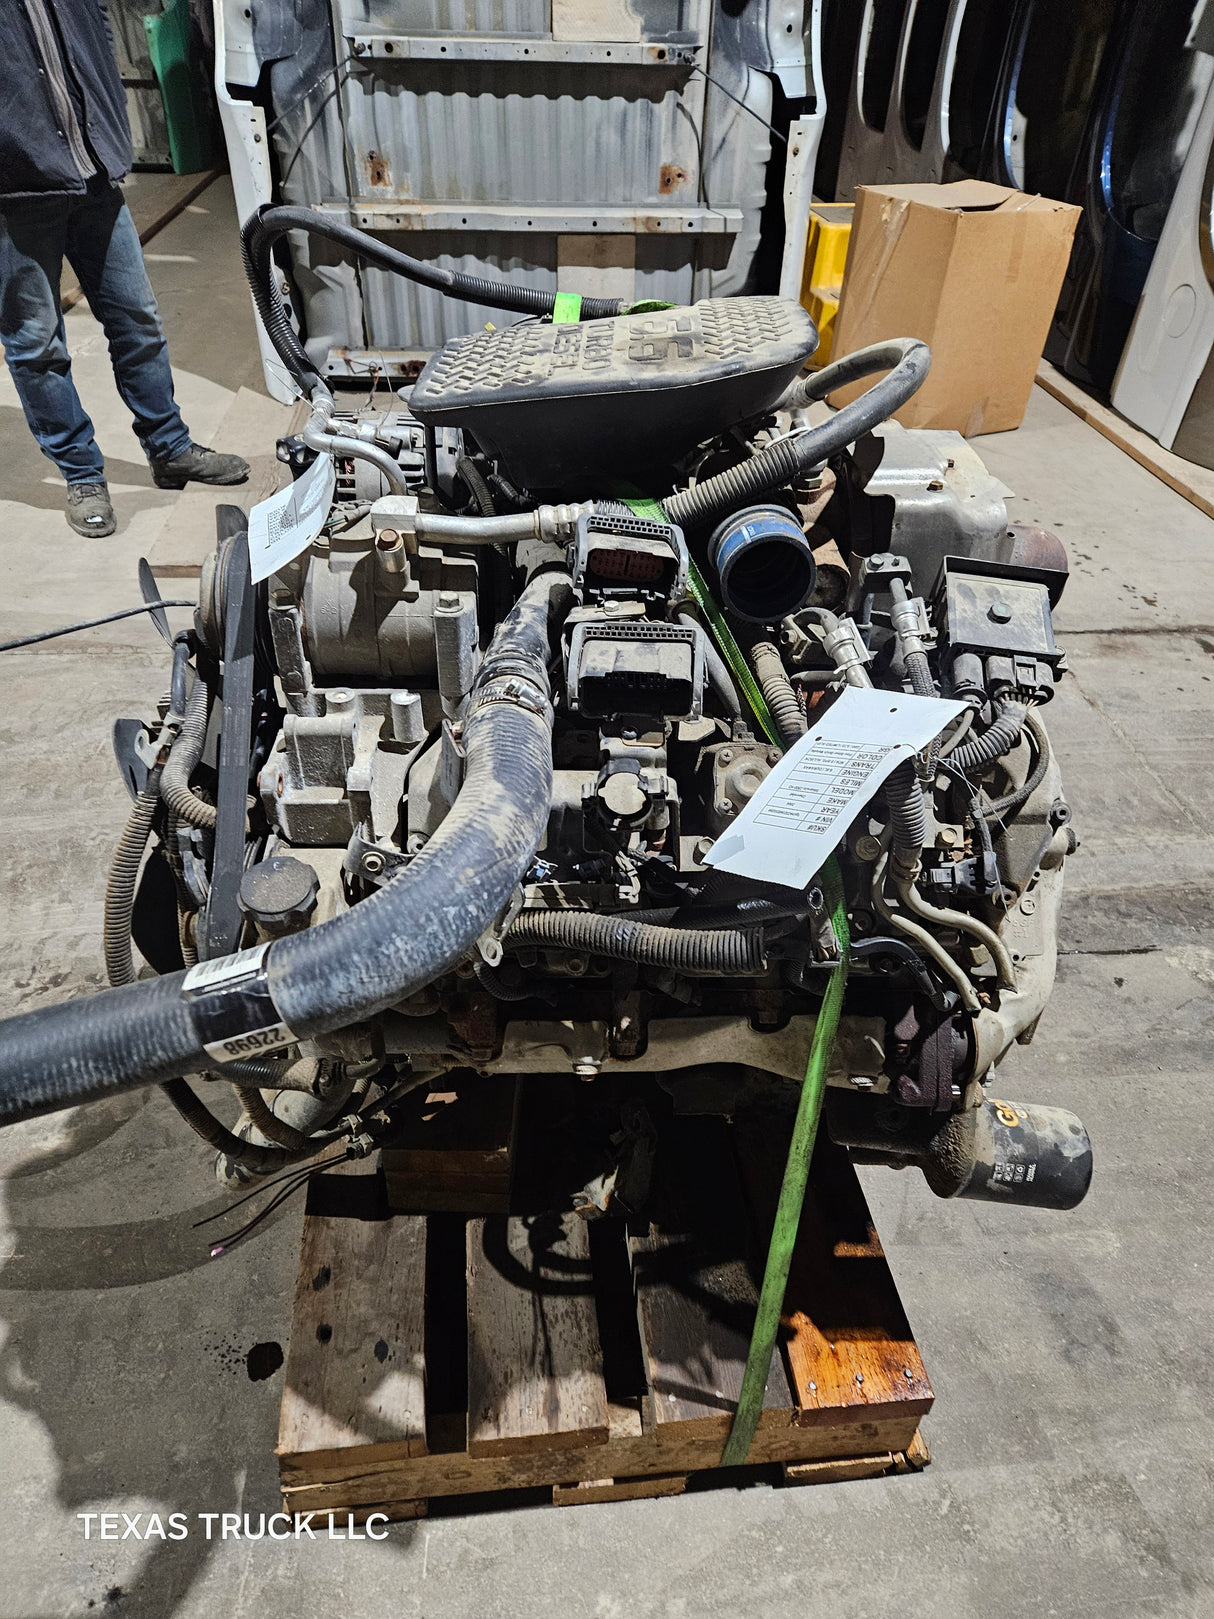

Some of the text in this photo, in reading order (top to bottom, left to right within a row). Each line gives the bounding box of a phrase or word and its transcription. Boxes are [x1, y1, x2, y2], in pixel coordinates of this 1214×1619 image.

[547, 324, 583, 376] DIESEL
[582, 321, 615, 370] TURBO
[856, 753, 883, 761] COLOR
[850, 761, 874, 770] TRANS
[842, 769, 869, 778] ENGINE
[840, 779, 861, 787] MILES
[831, 787, 855, 796] MODEL
[826, 797, 847, 805] MAKE
[820, 806, 839, 814] YEAR
[822, 816, 833, 824] VIN
[223, 1028, 285, 1055] 22698
